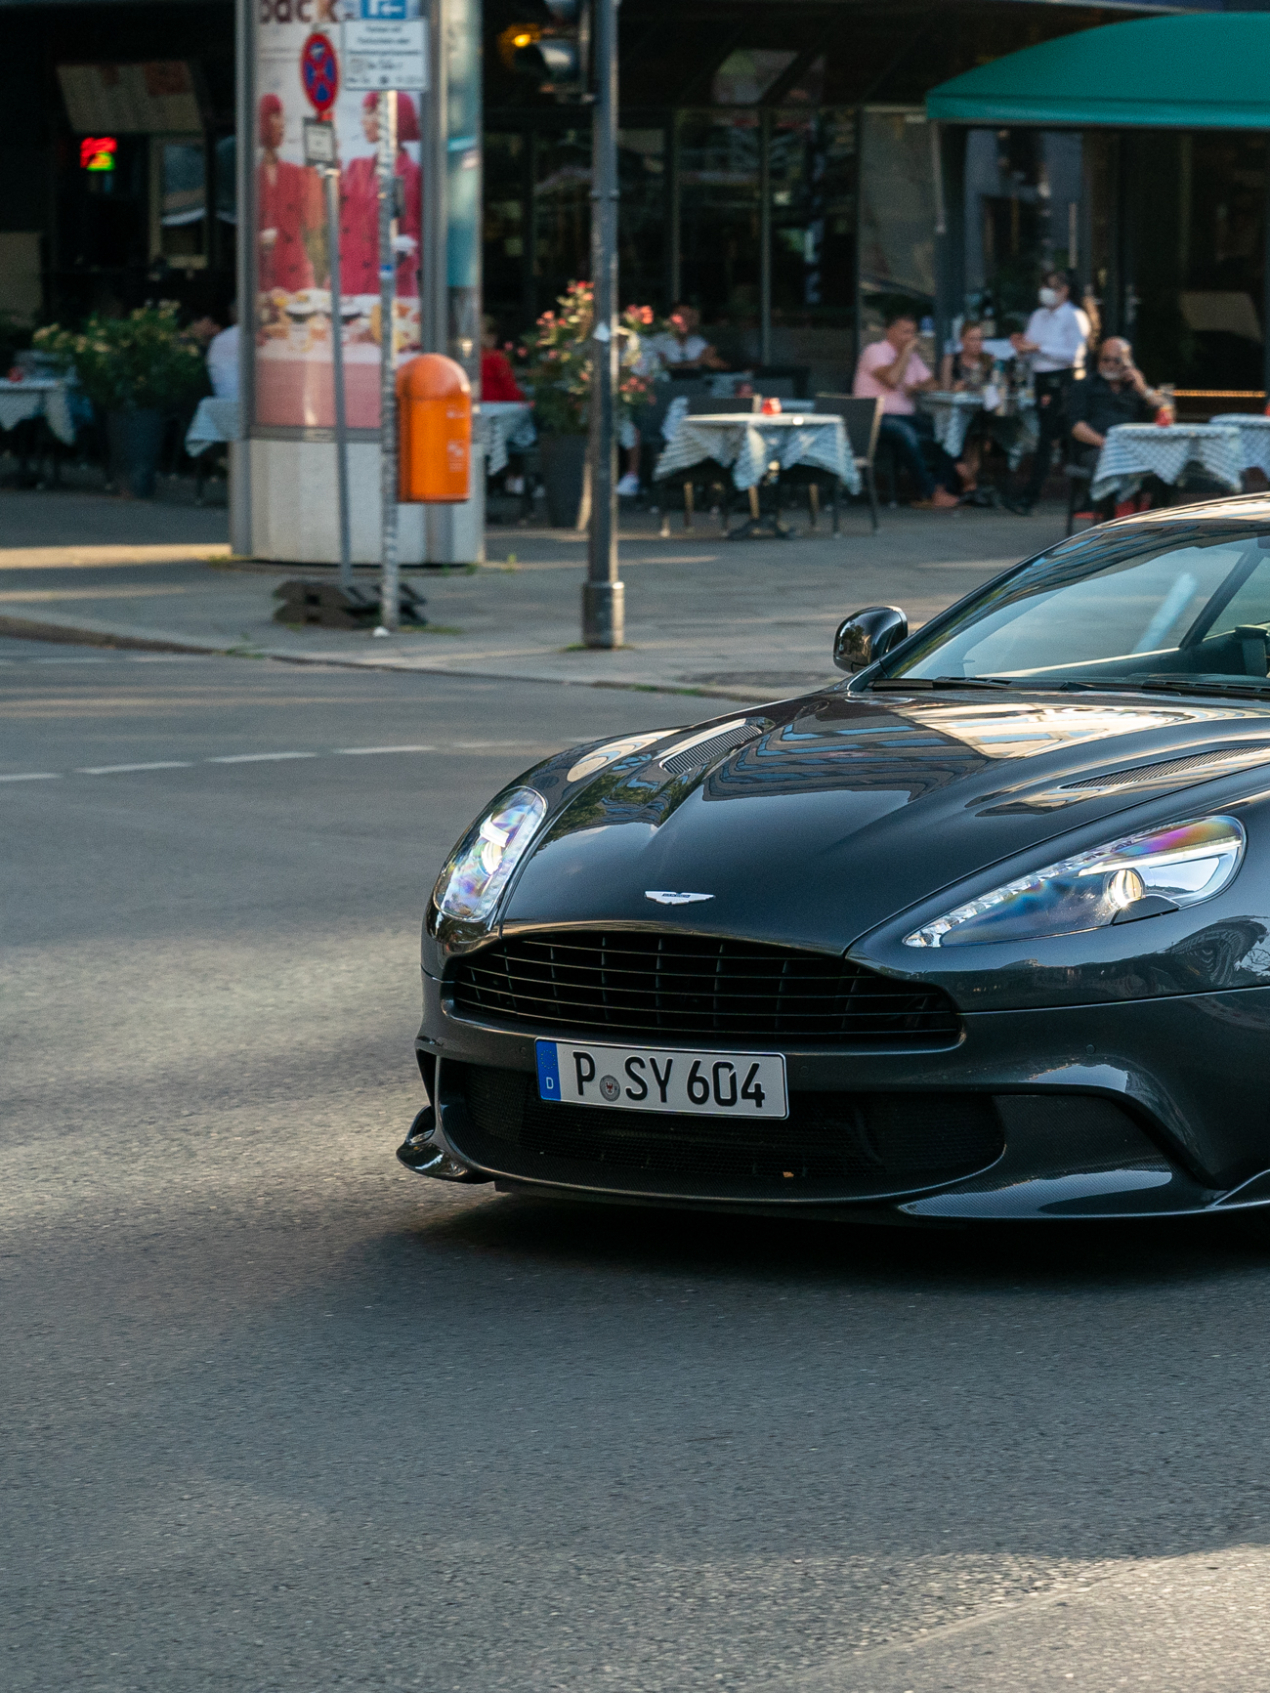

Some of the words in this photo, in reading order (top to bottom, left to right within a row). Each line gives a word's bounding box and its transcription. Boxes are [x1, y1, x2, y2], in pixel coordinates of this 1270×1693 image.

[546, 1077, 554, 1090] D
[573, 1051, 596, 1096] P
[687, 1060, 765, 1108] 604
